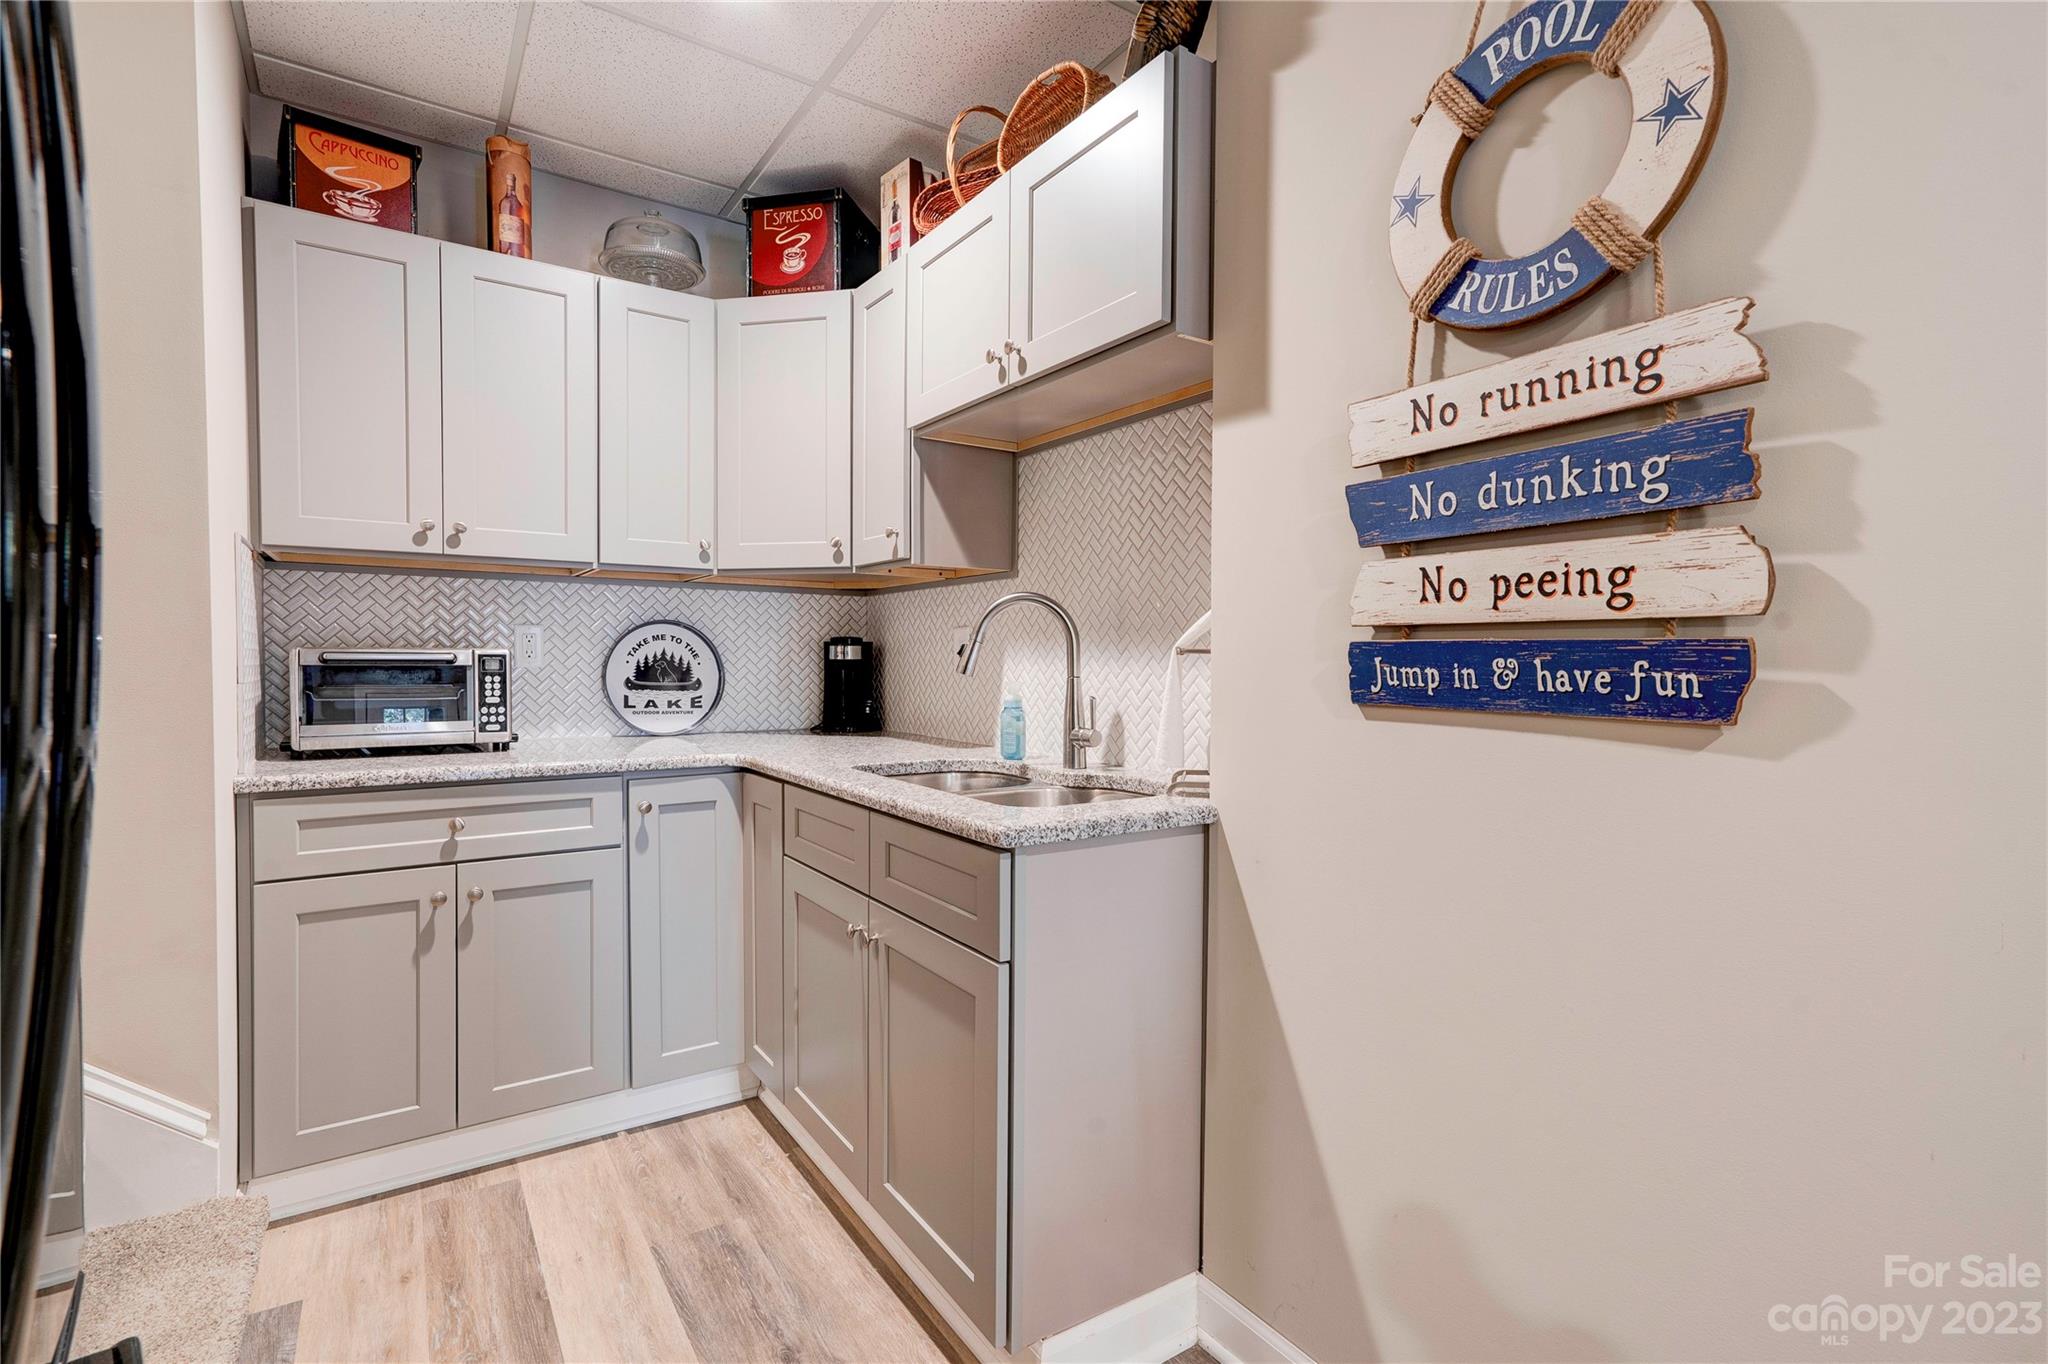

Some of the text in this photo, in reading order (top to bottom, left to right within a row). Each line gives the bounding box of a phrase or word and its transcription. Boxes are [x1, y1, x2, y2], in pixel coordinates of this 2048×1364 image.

[1481, 0, 1600, 86] POOL
[308, 131, 400, 171] CAPPUCCINO
[763, 206, 823, 231] ESPRESSO
[1448, 248, 1579, 313] RULES
[1409, 344, 1665, 436] No running
[1409, 454, 1672, 521] No dunking
[1418, 562, 1637, 612] No peeing
[627, 637, 650, 658] TAKE
[670, 635, 683, 645] TO
[684, 641, 700, 660] THE
[623, 694, 703, 709] LAKE
[1370, 656, 1703, 702] Jump in & have fun
